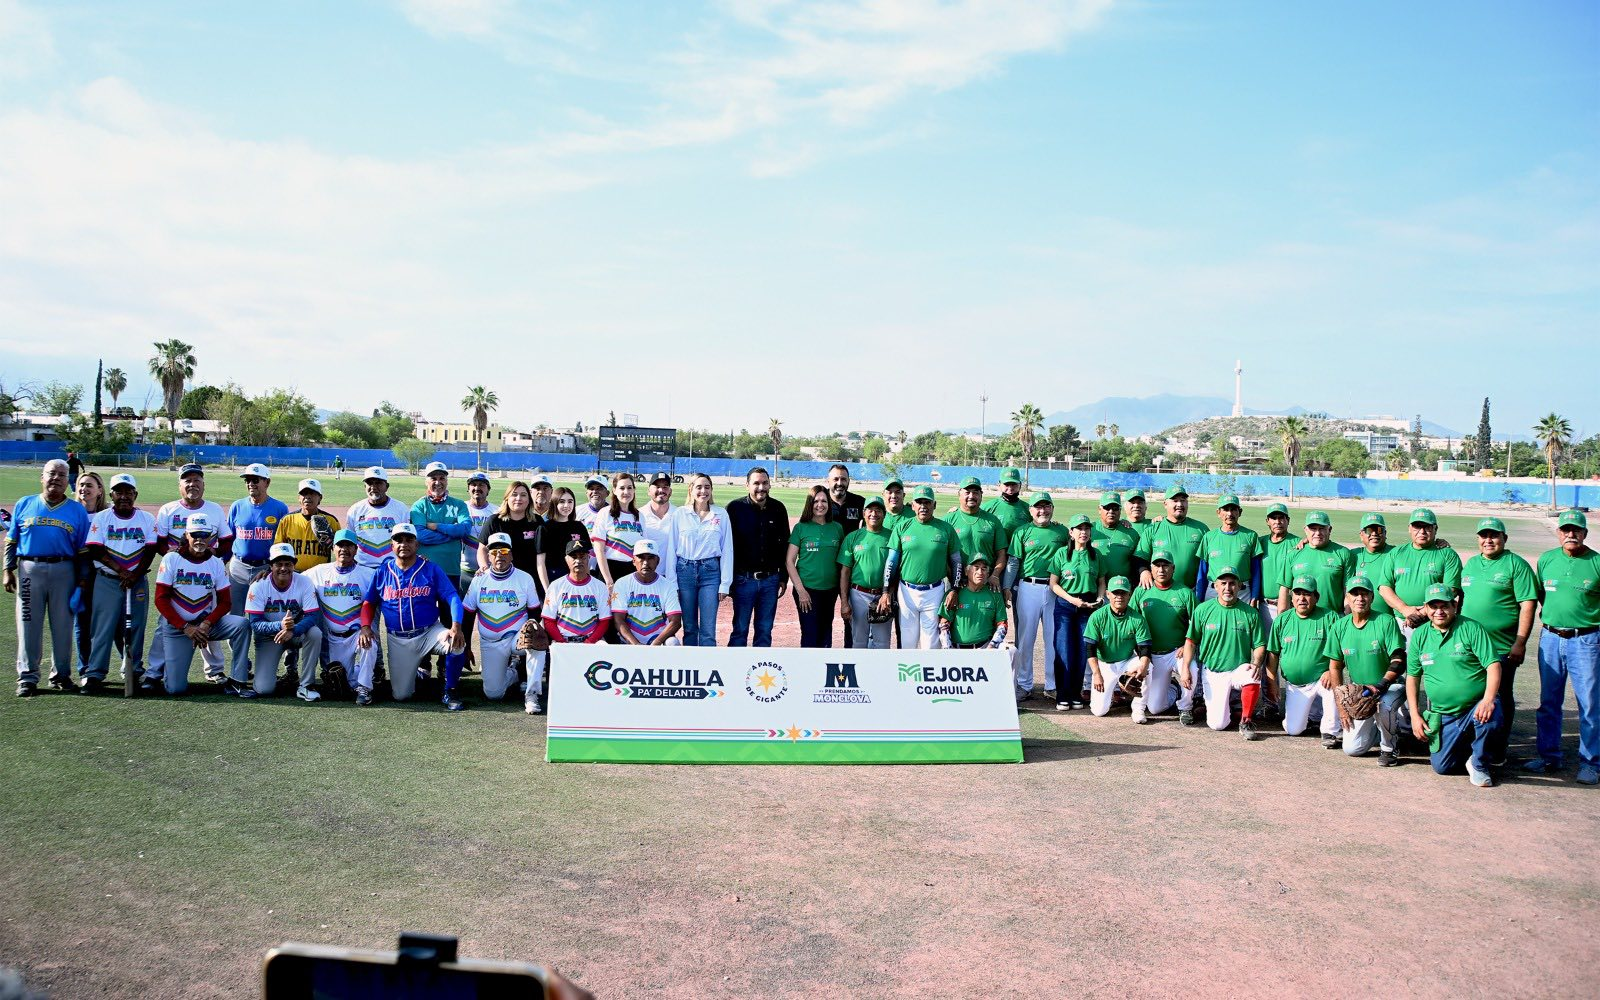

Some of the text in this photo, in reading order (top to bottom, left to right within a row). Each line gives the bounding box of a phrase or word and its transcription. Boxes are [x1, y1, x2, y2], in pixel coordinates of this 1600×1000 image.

[108, 528, 145, 540] MVA
[176, 572, 213, 585] MVA
[324, 583, 361, 597] MVA
[480, 590, 519, 603] MVA
[22, 577, 31, 621] BOMBAS
[562, 595, 598, 608] MVA
[627, 594, 662, 607] MVA
[758, 661, 782, 671] PASOS
[898, 663, 988, 682] MEJORA
[584, 660, 724, 691] COAHUILA
[655, 689, 700, 698] DELANTE
[746, 686, 788, 703] DE GIGANTE
[916, 686, 974, 695] COAHUILA
[813, 694, 871, 703] MONCLOVA
